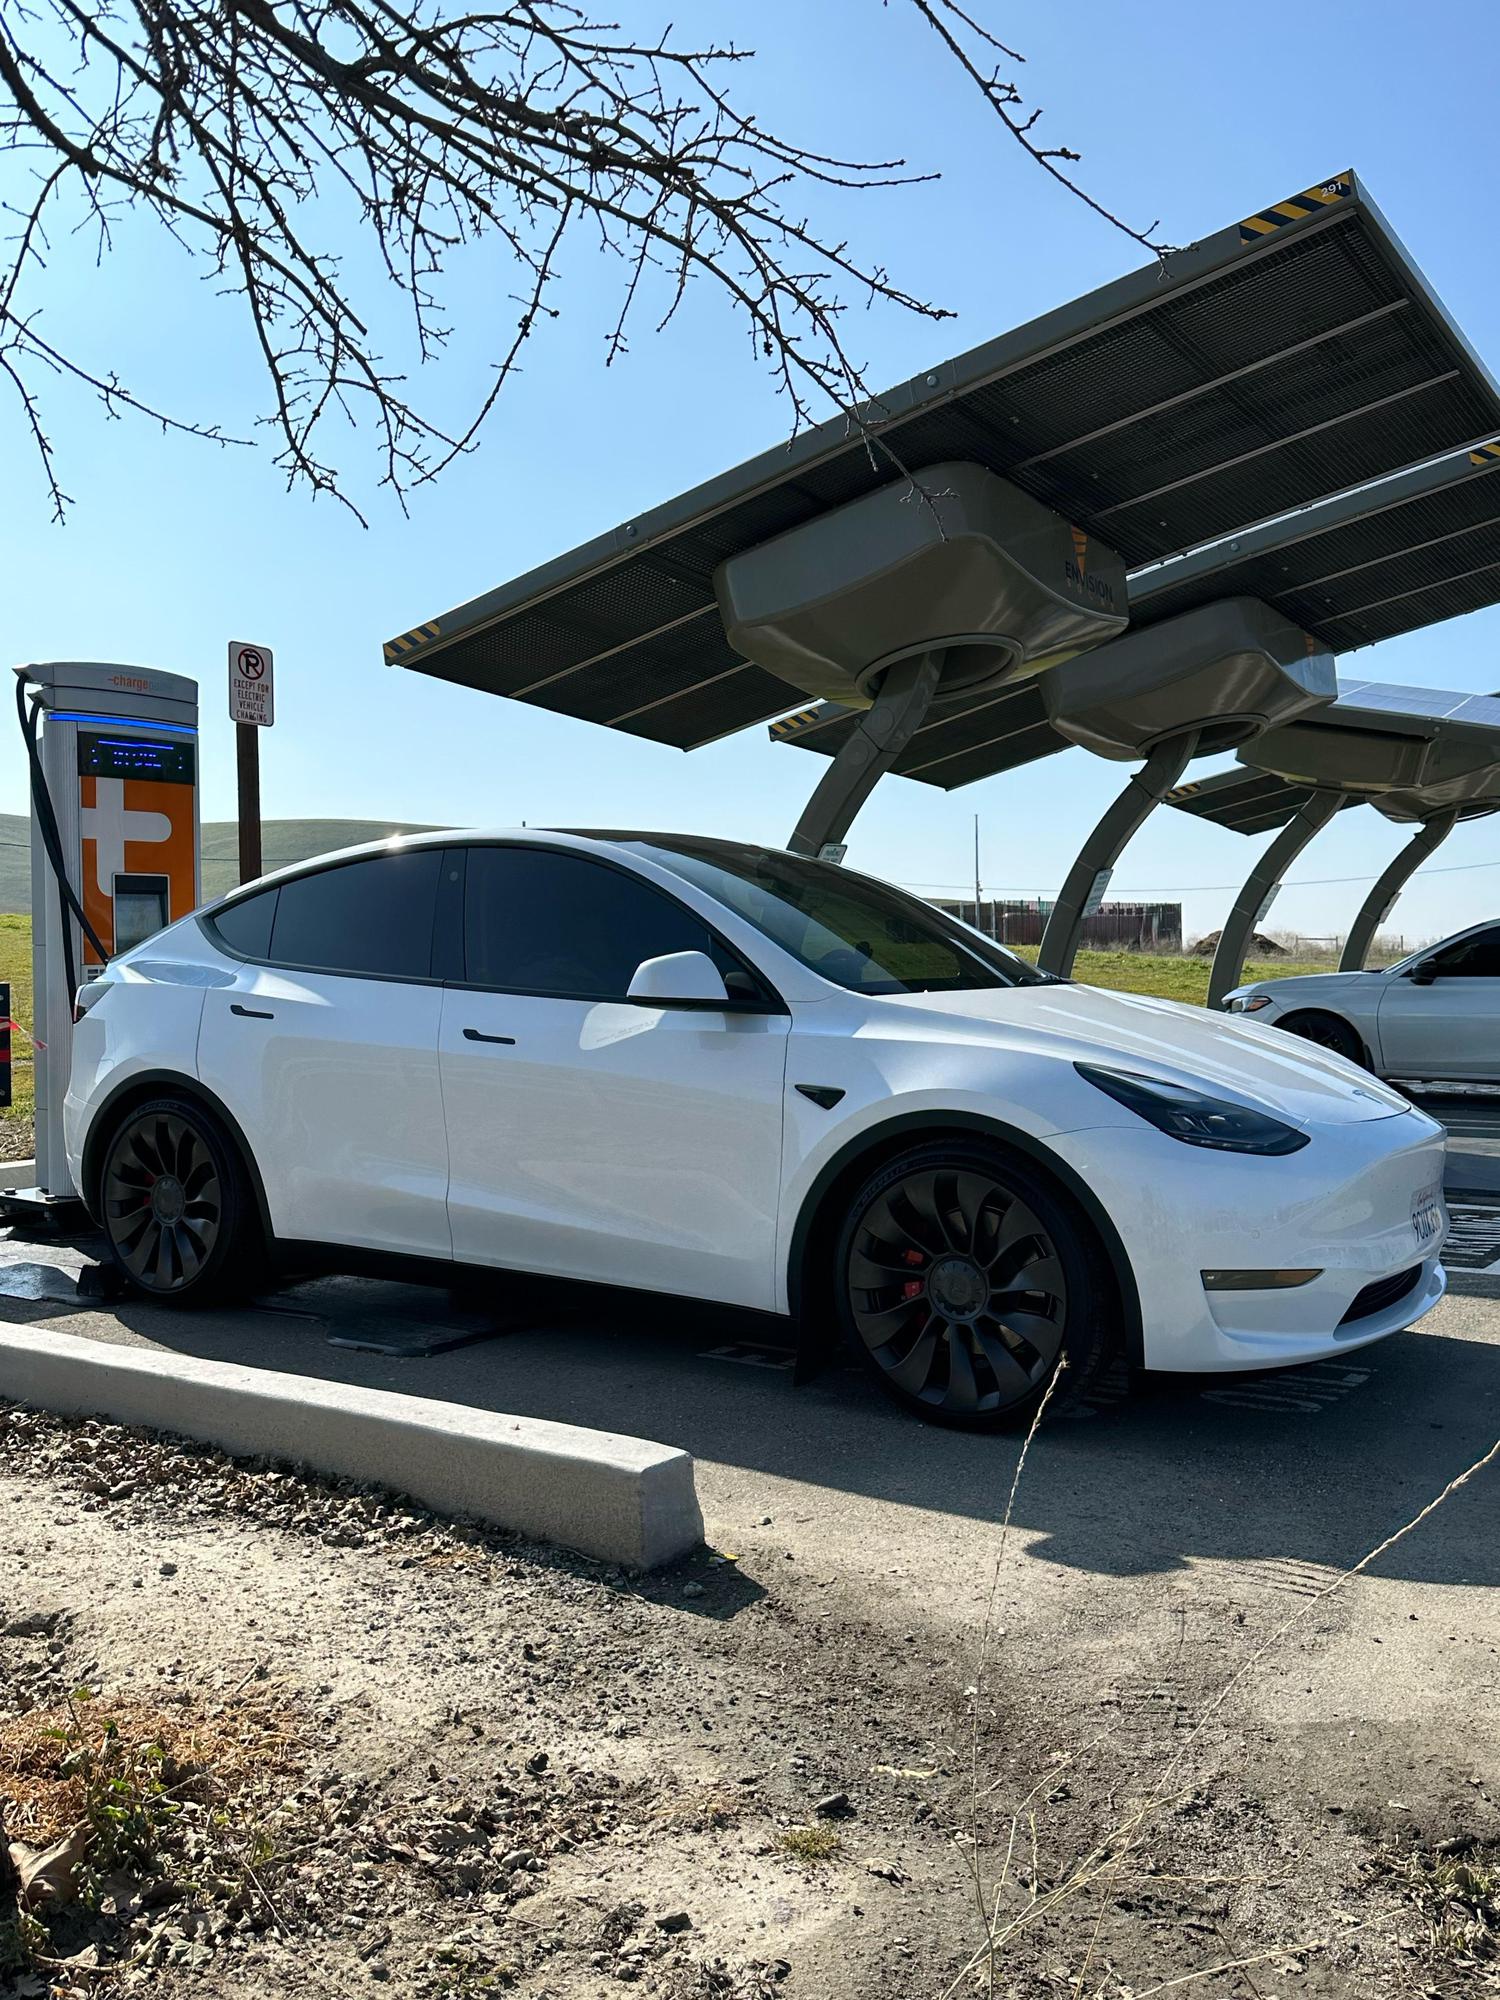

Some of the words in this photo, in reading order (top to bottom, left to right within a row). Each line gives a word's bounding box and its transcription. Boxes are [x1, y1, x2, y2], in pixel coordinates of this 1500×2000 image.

[1321, 182, 1342, 198] 291
[1065, 560, 1113, 602] ENVISION
[233, 679, 256, 691] EXCEPT
[257, 683, 270, 693] FOR
[237, 689, 265, 703] ELECTRIC
[239, 700, 264, 712] VEHICLE
[236, 710, 268, 723] CHARGING
